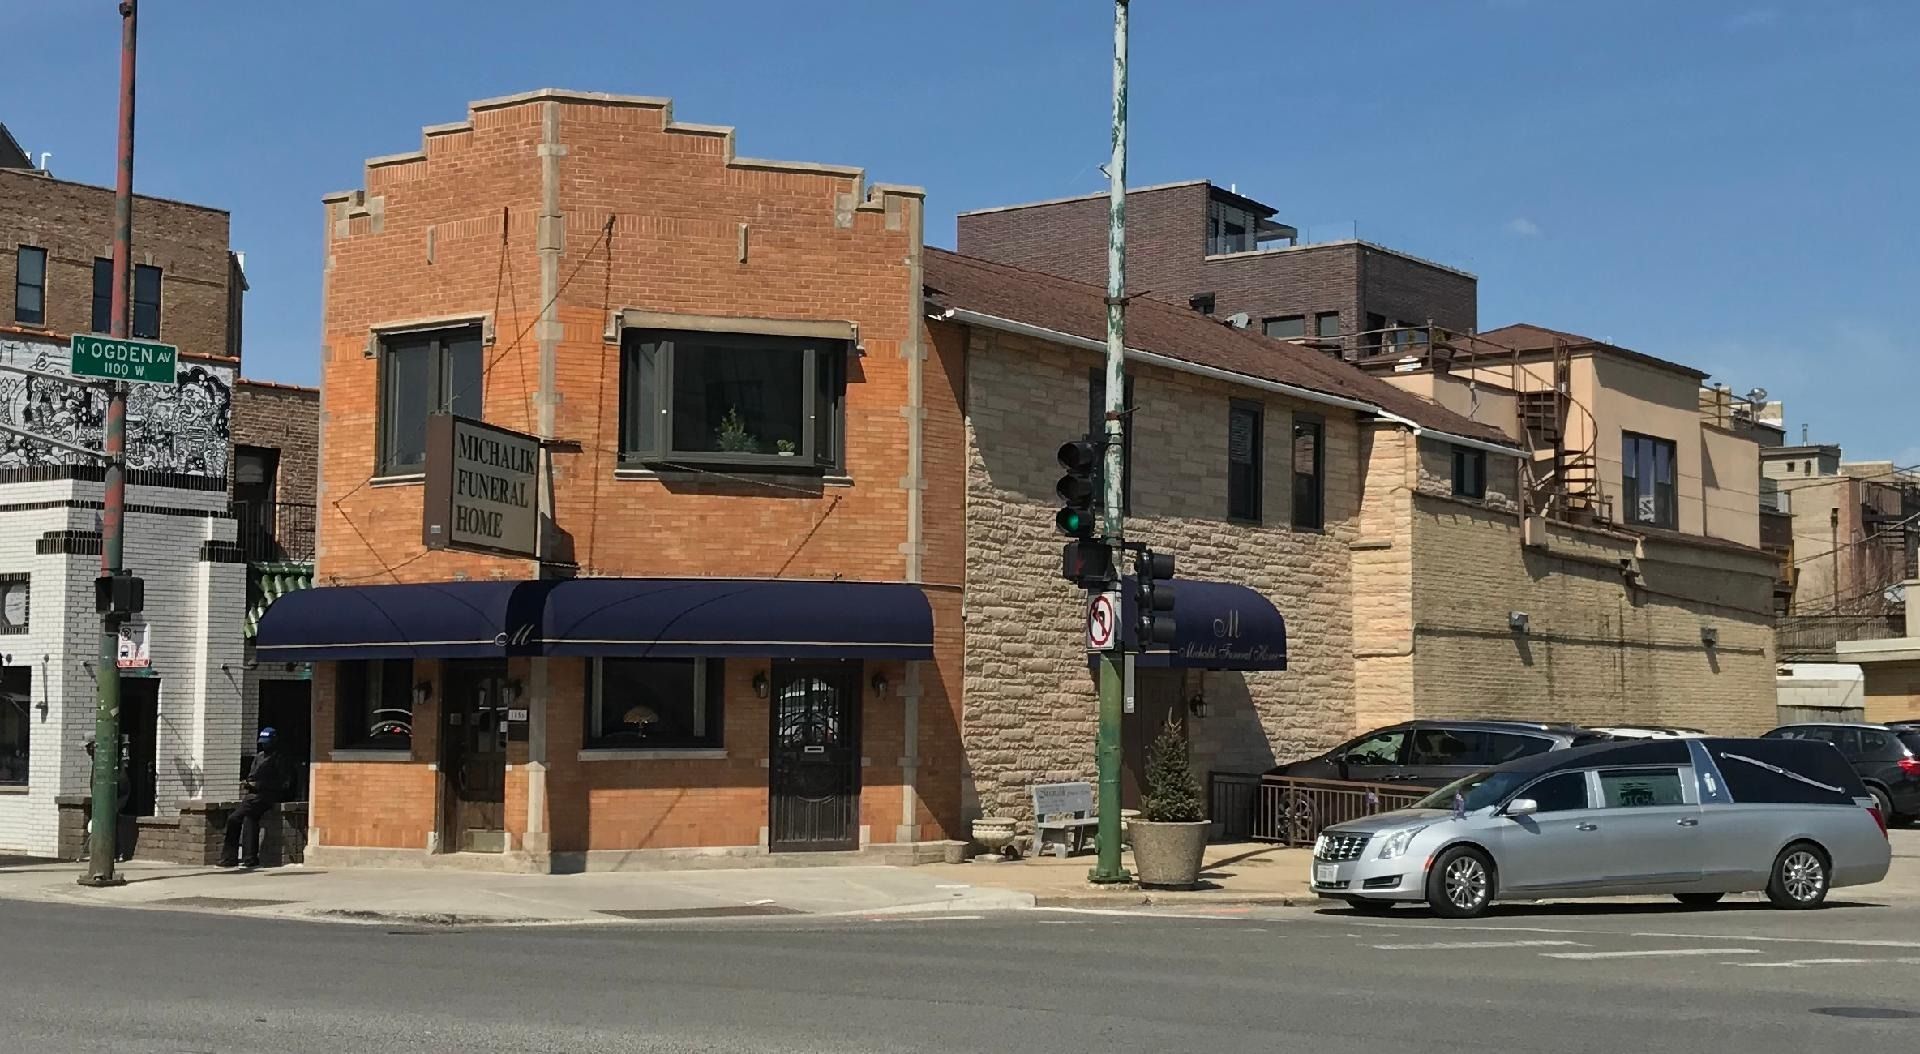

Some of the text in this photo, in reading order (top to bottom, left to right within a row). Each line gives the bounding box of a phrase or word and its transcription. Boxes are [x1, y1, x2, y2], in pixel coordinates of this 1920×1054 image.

[77, 342, 171, 363] N OGDEN AV
[104, 361, 145, 376] 1100 W
[458, 432, 535, 475] MICHALIK
[457, 469, 529, 508] FUNERAL
[456, 505, 503, 538] HOME
